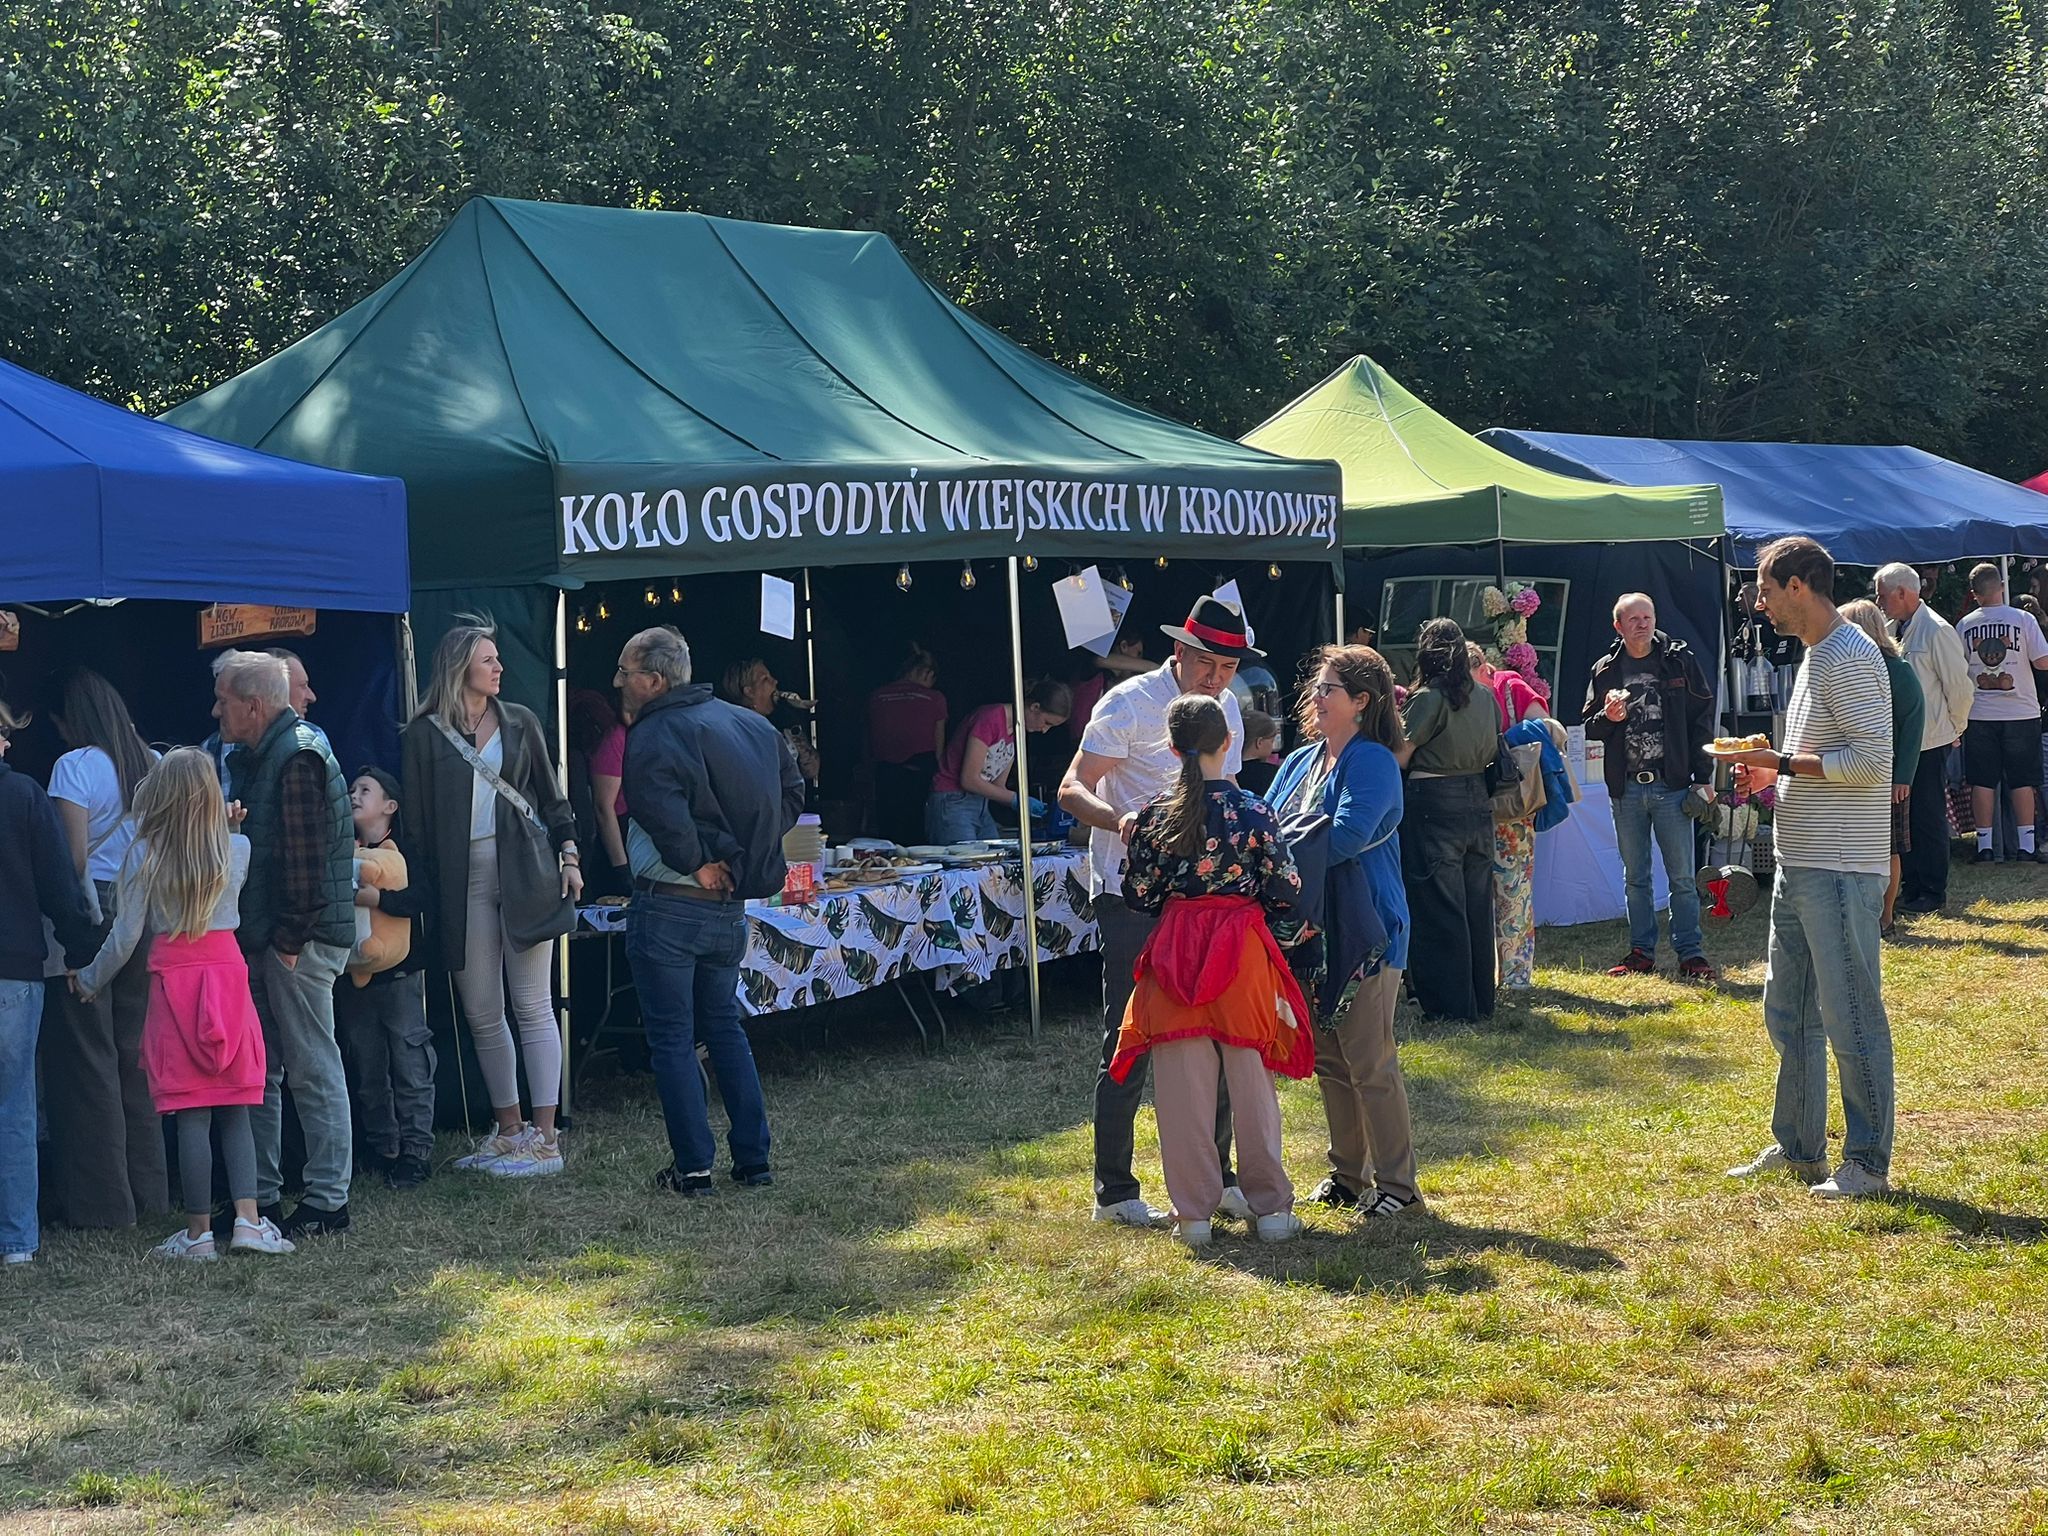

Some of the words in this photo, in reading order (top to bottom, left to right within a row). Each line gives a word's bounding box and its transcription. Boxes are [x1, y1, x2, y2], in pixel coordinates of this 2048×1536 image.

[559, 488, 690, 555] KOŁO
[700, 467, 930, 543] GOSPODYŃ
[938, 479, 1132, 543] WIEJSKICH
[1136, 484, 1171, 533] W
[1177, 486, 1338, 550] KROKOWEJ
